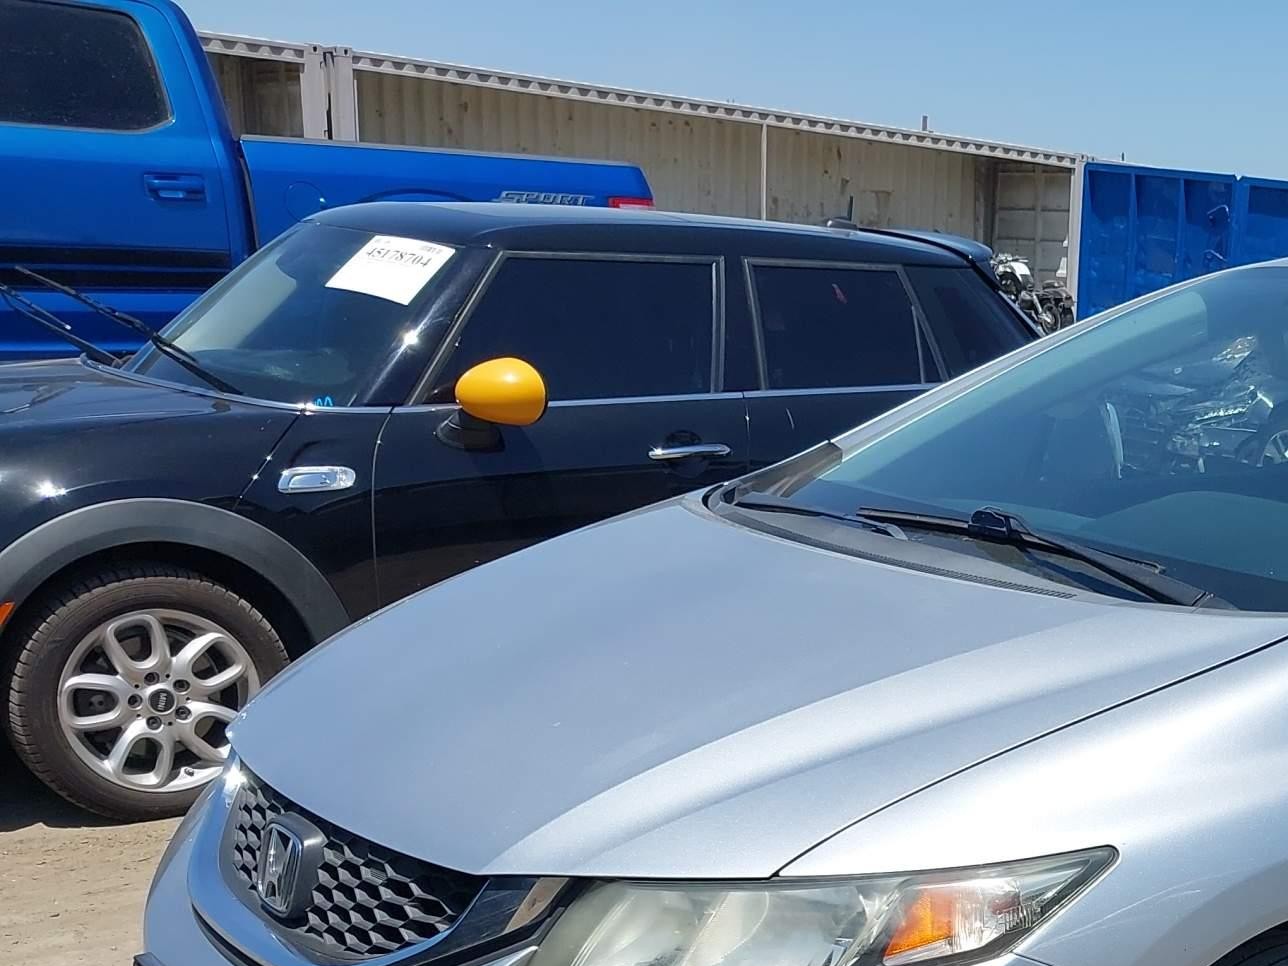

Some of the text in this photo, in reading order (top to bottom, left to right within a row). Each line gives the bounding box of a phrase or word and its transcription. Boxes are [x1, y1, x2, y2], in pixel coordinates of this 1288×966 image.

[494, 191, 594, 206] SPORT
[366, 247, 432, 267] 45178704
[157, 692, 168, 710] MINI
